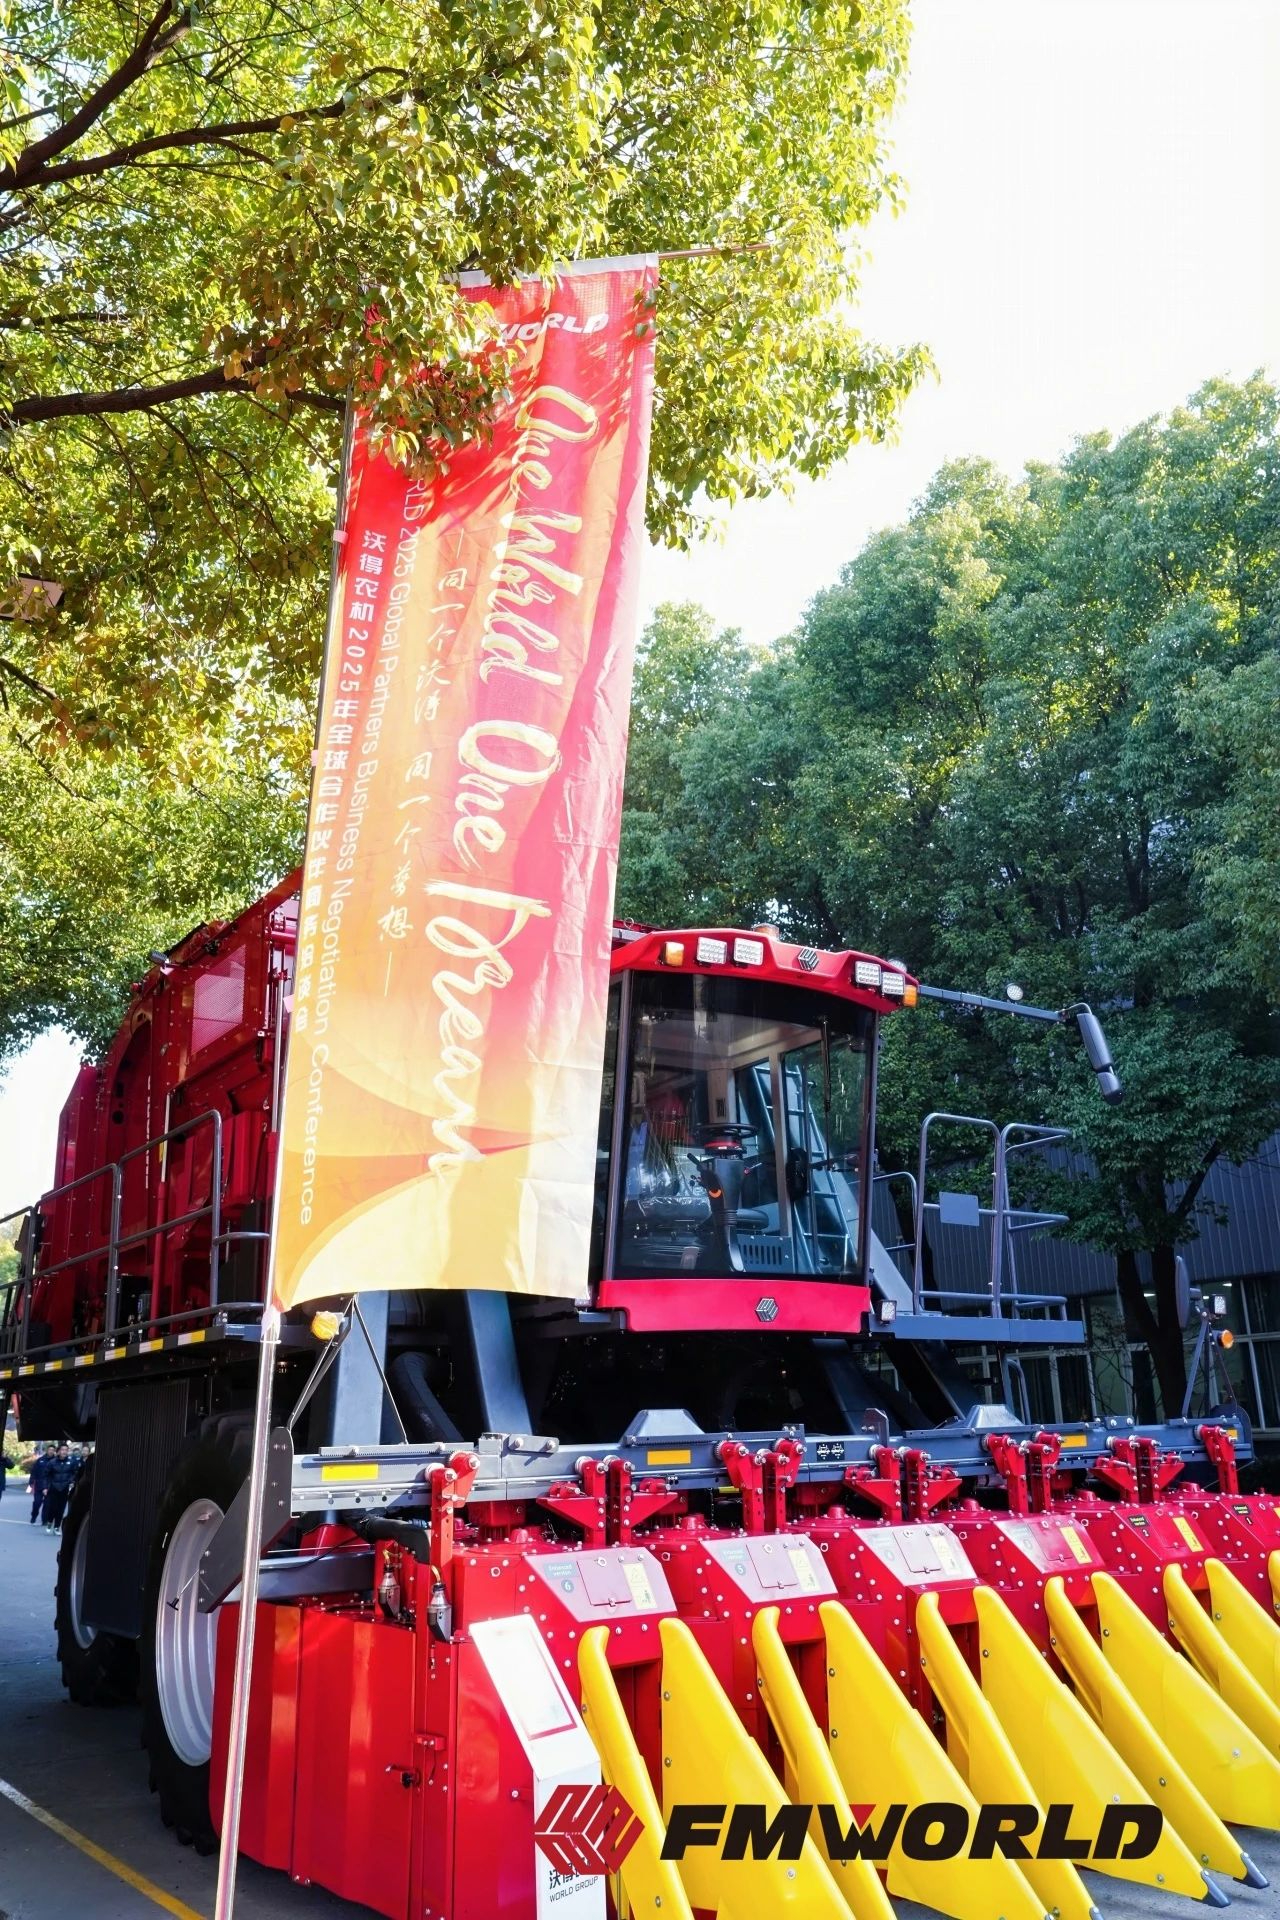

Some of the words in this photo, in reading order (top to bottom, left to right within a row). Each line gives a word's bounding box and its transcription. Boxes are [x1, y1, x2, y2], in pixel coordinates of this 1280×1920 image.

[511, 384, 600, 498] One
[393, 525, 421, 578] 2025
[480, 507, 584, 686] World
[380, 582, 411, 652] Global
[362, 655, 399, 755] Partners
[336, 759, 380, 872] Business
[453, 719, 562, 869] One
[313, 878, 355, 1036] Negotiation
[423, 880, 552, 1184] Dream
[300, 1043, 330, 1226] Conference
[564, 1580, 571, 1591] 6
[549, 1886, 574, 1903] WORLD
[575, 1875, 599, 1892] GROUP
